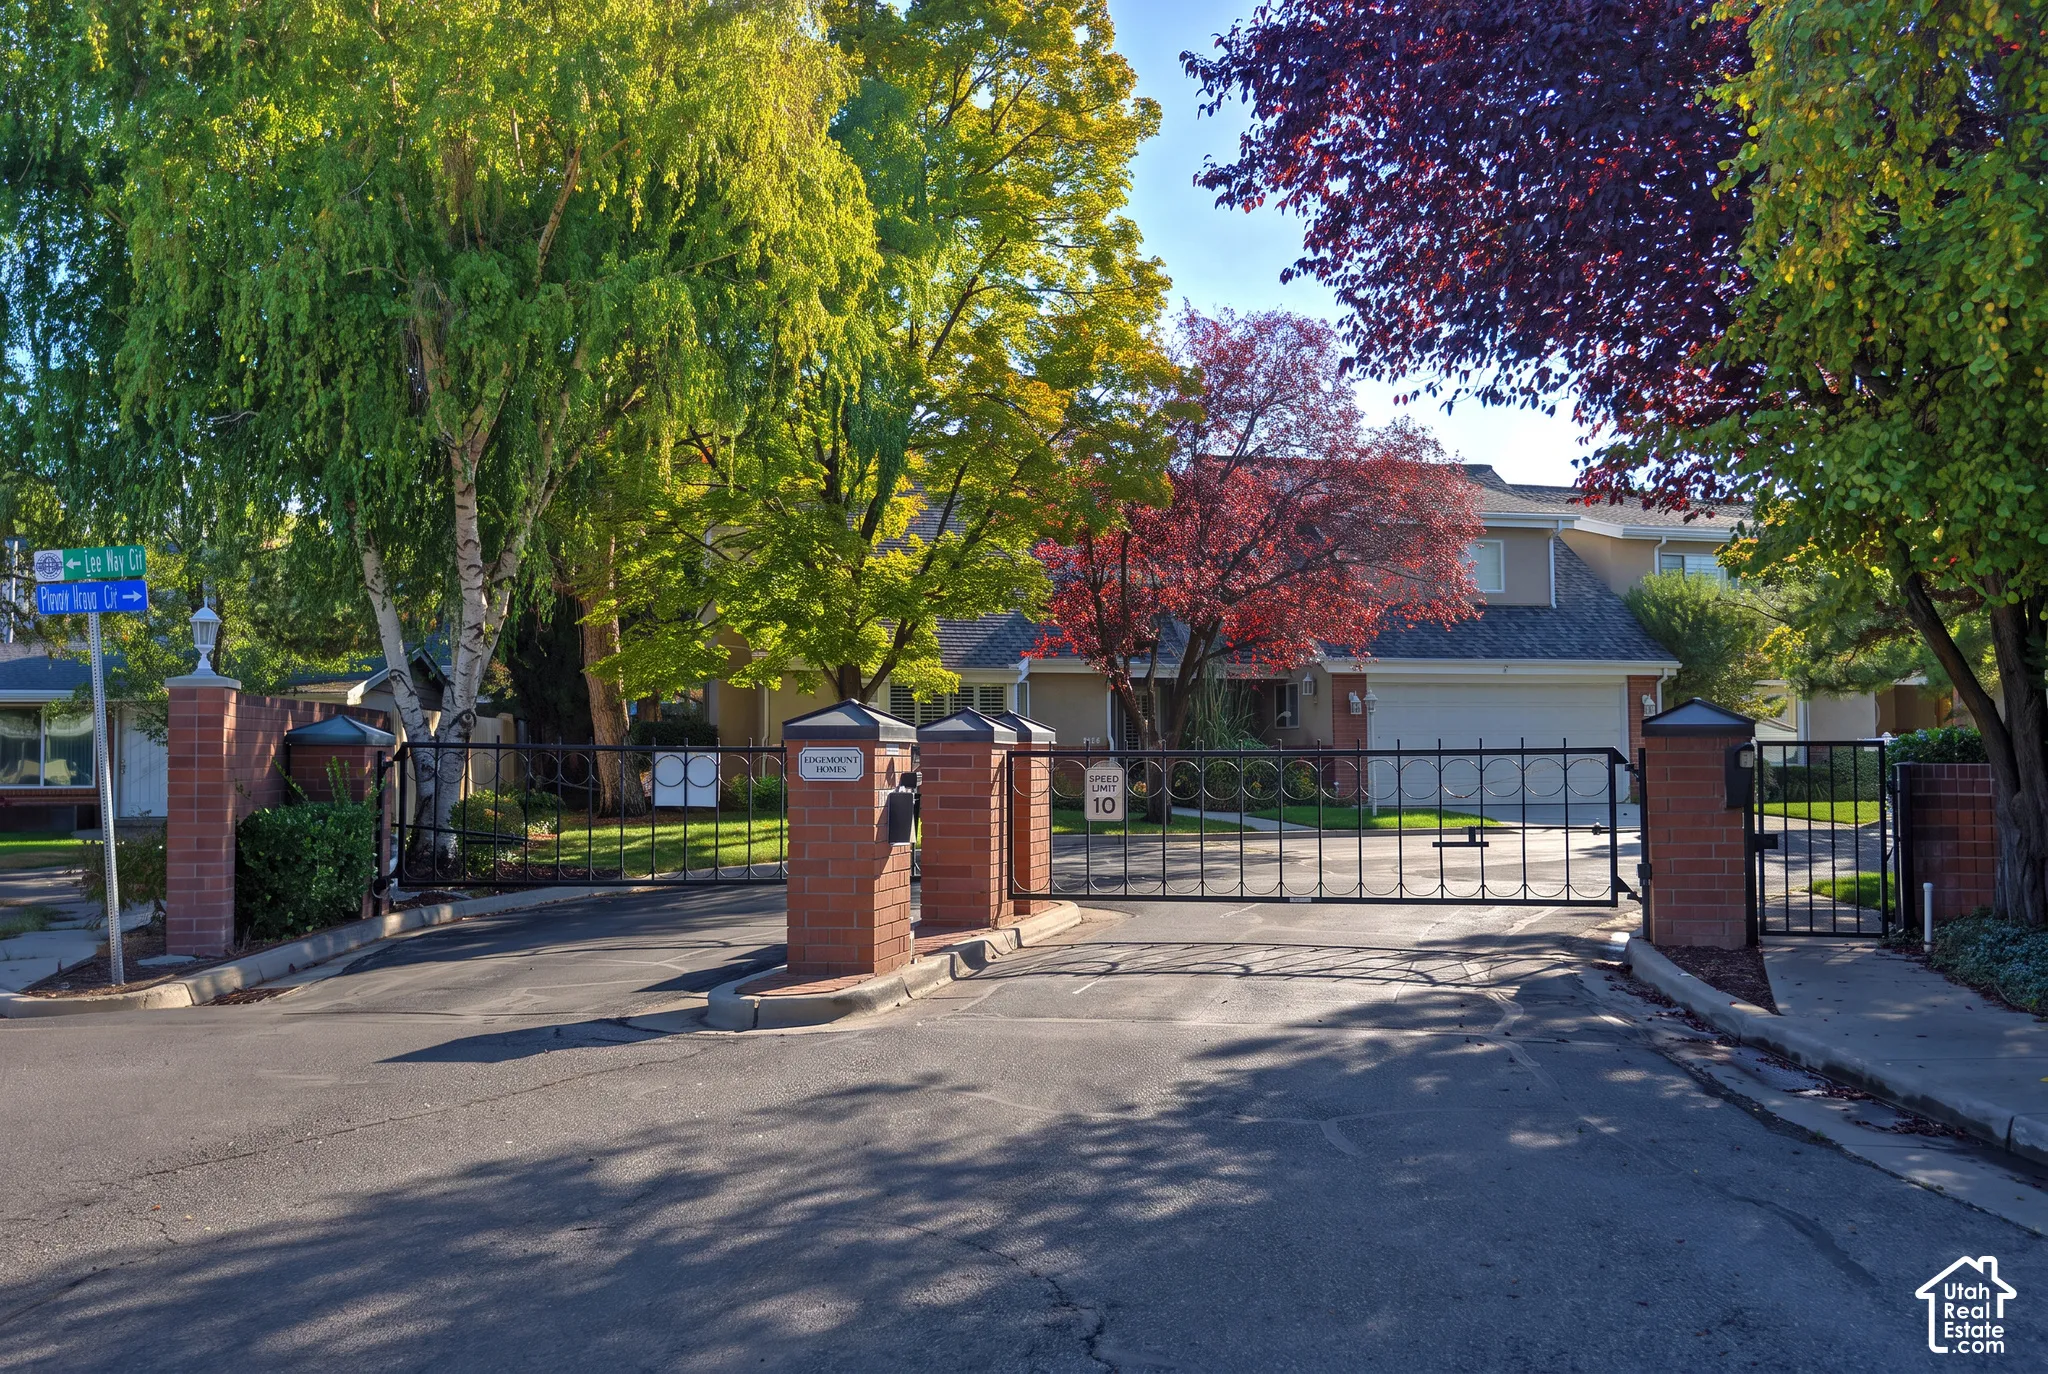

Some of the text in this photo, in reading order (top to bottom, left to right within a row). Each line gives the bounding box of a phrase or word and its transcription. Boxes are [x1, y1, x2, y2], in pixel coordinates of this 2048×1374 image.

[84, 552, 102, 574] Lee
[106, 549, 124, 577] Way
[804, 756, 859, 764] EDGEMOUNT
[816, 765, 847, 773] HOMES
[1089, 775, 1119, 783] SPEED
[1092, 784, 1117, 792] LIMIT
[1093, 796, 1116, 814] 10
